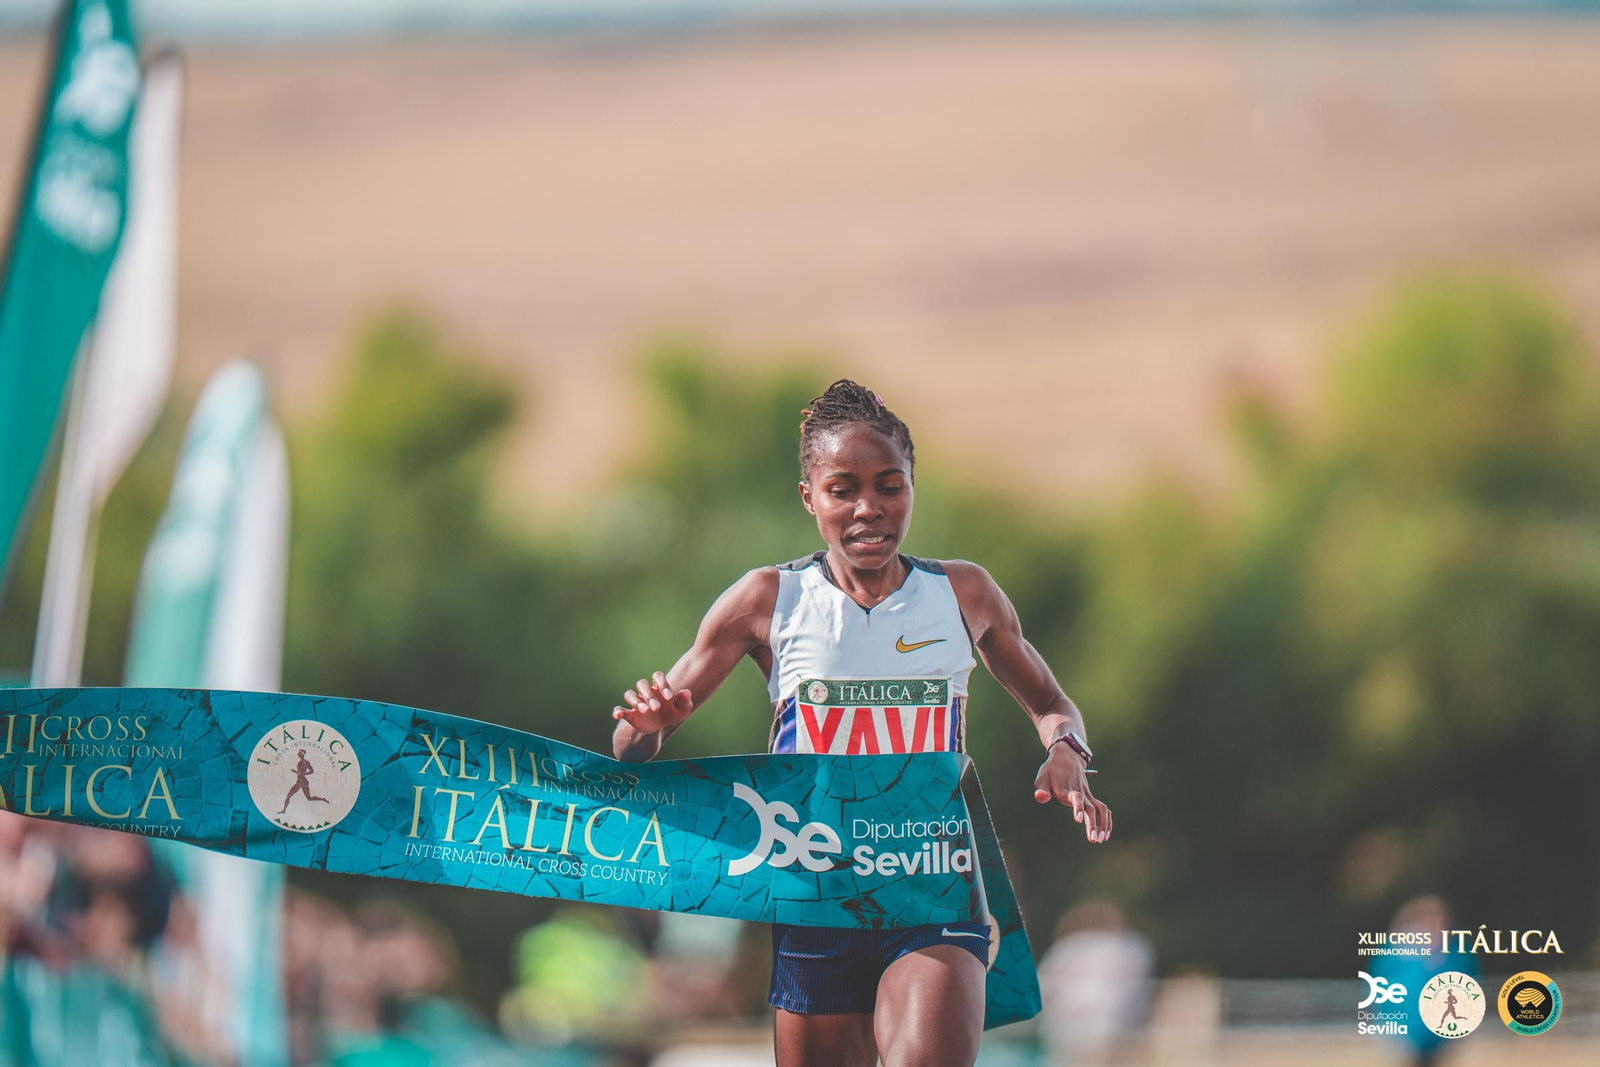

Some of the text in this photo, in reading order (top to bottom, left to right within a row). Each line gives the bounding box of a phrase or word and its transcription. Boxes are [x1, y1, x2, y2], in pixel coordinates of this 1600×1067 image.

[839, 682, 912, 700] ITÁLICA
[40, 715, 148, 742] CROSS
[800, 704, 946, 755] YAVI
[38, 743, 183, 760] INTERNACIONAL
[257, 725, 352, 772] ITÁLICA
[417, 733, 640, 788] XLIII CROSS
[0, 753, 184, 820] LICA
[543, 778, 678, 806] INTERNACIONAL
[406, 784, 671, 867] ITÁLICA
[853, 815, 970, 843] Diputación
[404, 843, 668, 886] INTERNATIONAL CROSS COUNTRY
[853, 841, 972, 876] Sevilla
